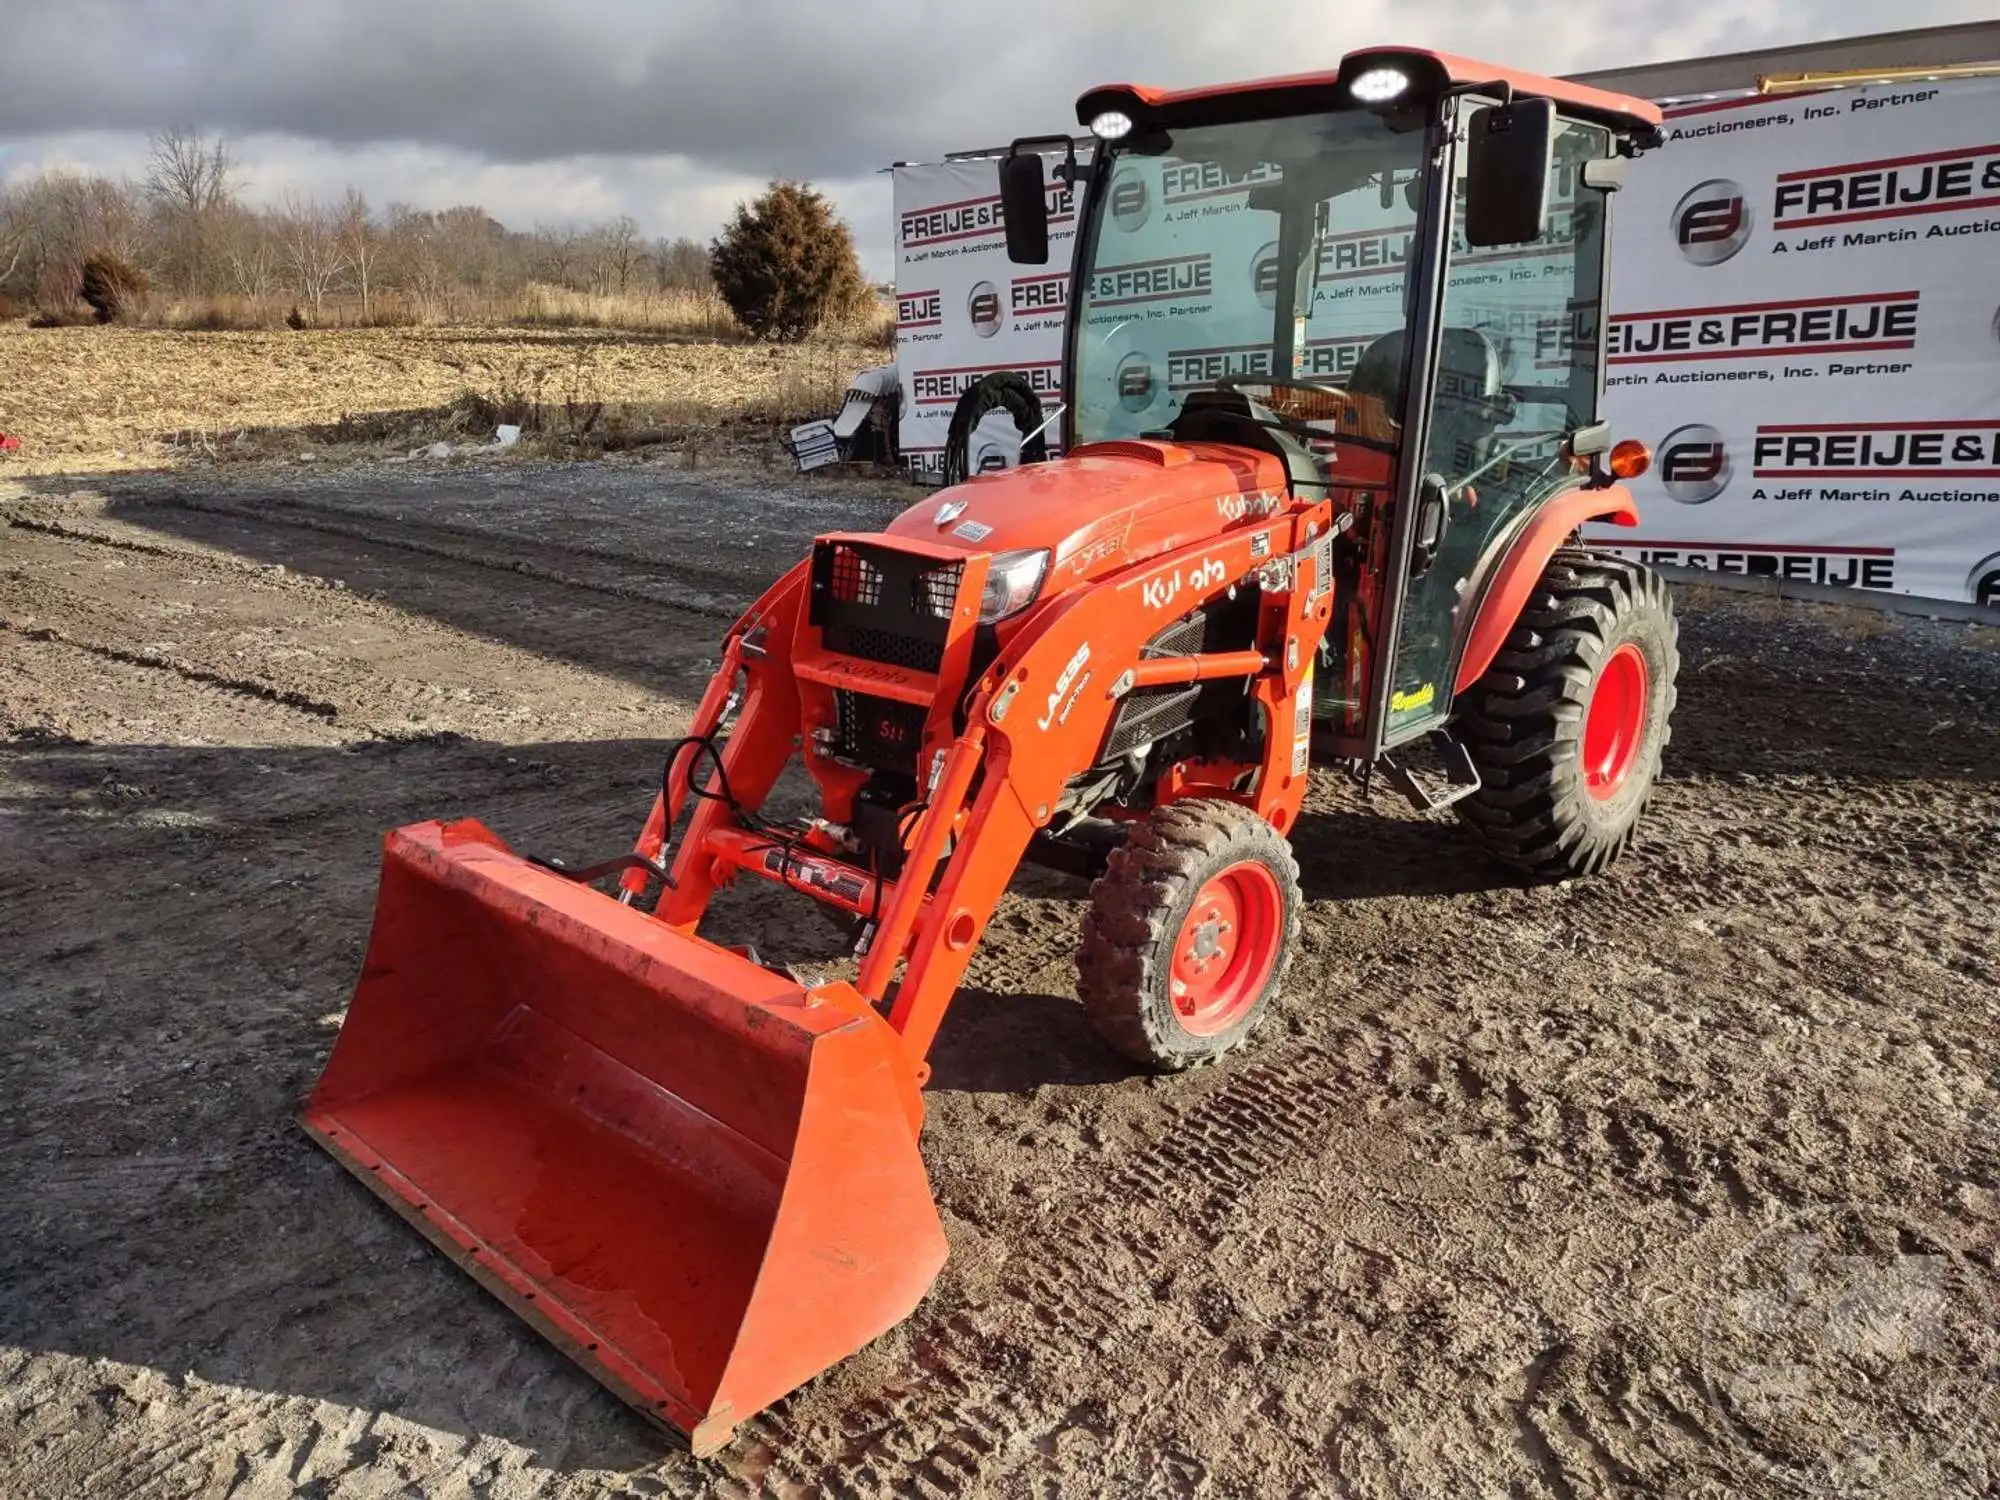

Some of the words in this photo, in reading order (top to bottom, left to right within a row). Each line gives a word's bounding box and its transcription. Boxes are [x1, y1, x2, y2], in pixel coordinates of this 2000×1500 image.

[1670, 114, 1795, 142] Auctioneers,
[1804, 106, 1841, 120] Inc.
[1851, 89, 1939, 112] Partner
[1164, 213, 1173, 222] A
[1772, 241, 1788, 253] A
[1796, 236, 1836, 251] Jeff
[1843, 227, 1917, 247] Martin
[1315, 290, 1326, 301] A
[1330, 282, 1354, 299] Jeff
[1014, 323, 1021, 332] A
[1605, 374, 1648, 387] artin
[1655, 368, 1774, 386] Auctioneers,
[1784, 366, 1819, 378] Inc.
[1828, 362, 1912, 376] Partner
[1752, 489, 1767, 500] A
[1774, 489, 1812, 500] Jeff
[1820, 489, 1891, 501] Martin
